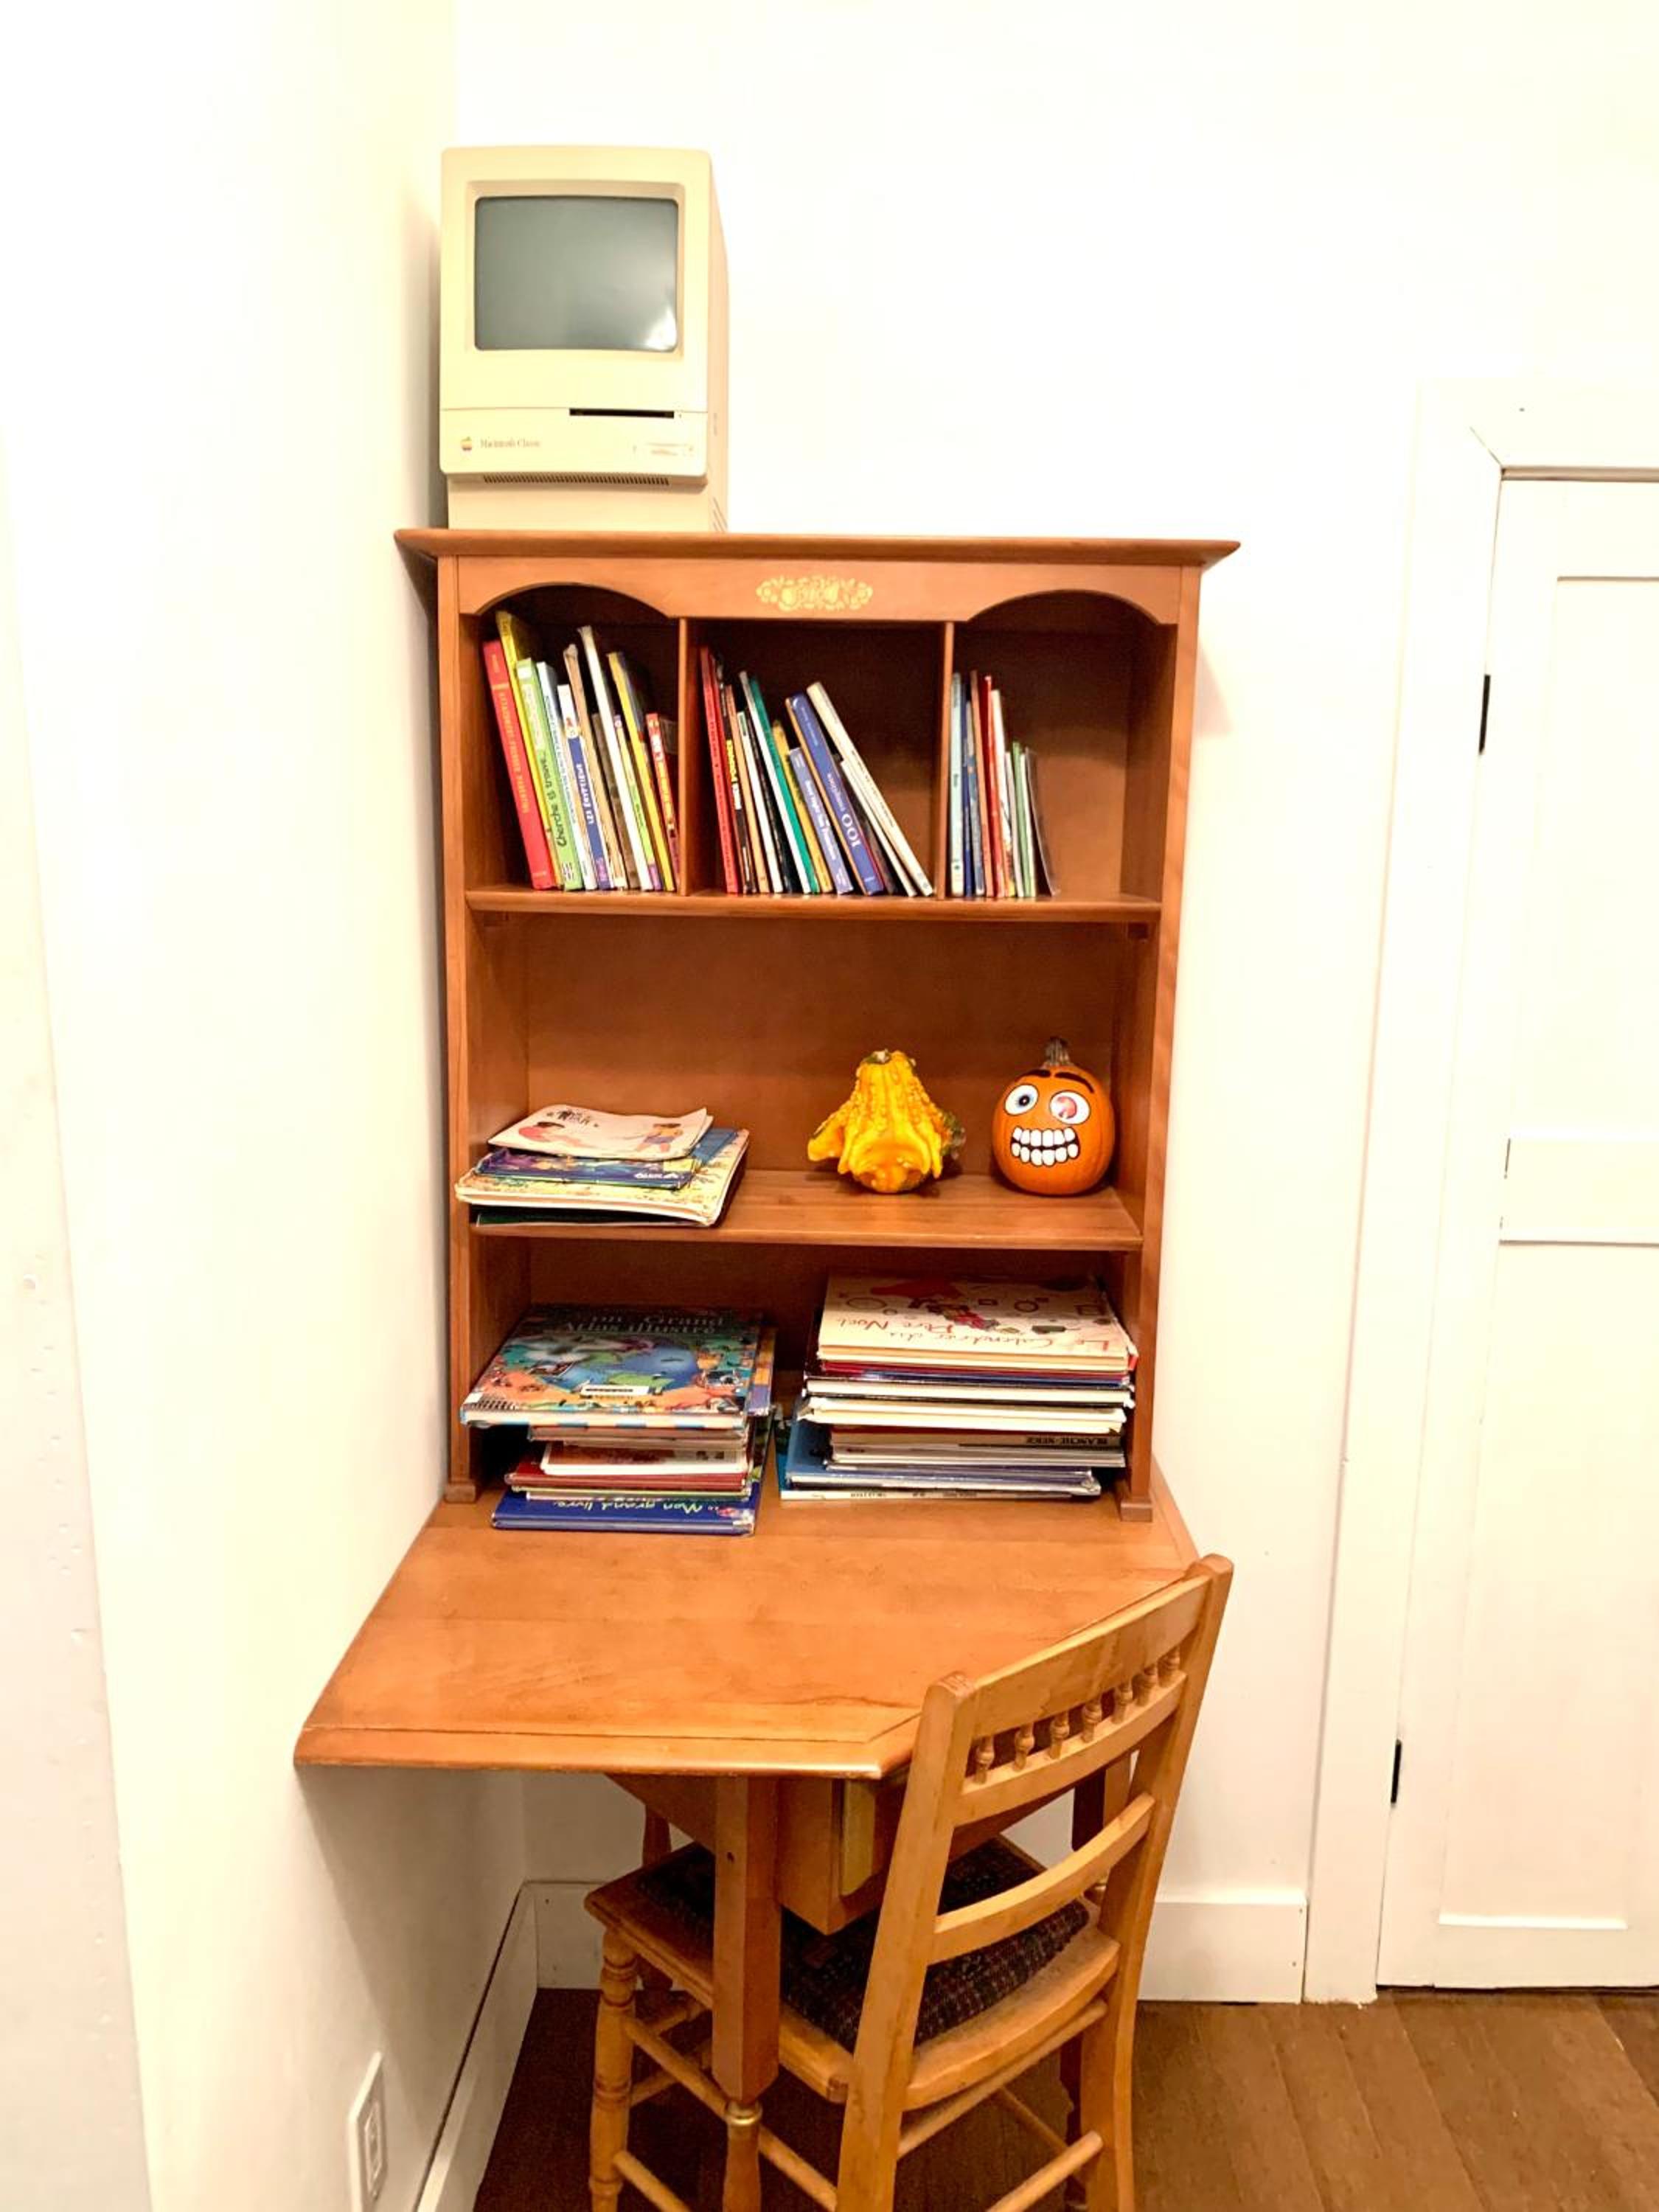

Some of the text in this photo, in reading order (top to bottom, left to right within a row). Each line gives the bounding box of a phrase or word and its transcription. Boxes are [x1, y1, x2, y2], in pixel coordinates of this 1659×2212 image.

[551, 804, 567, 847] Cherche
[841, 813, 861, 847] 100
[935, 1334, 1053, 1349] Calendrier
[601, 1499, 655, 1510] grand
